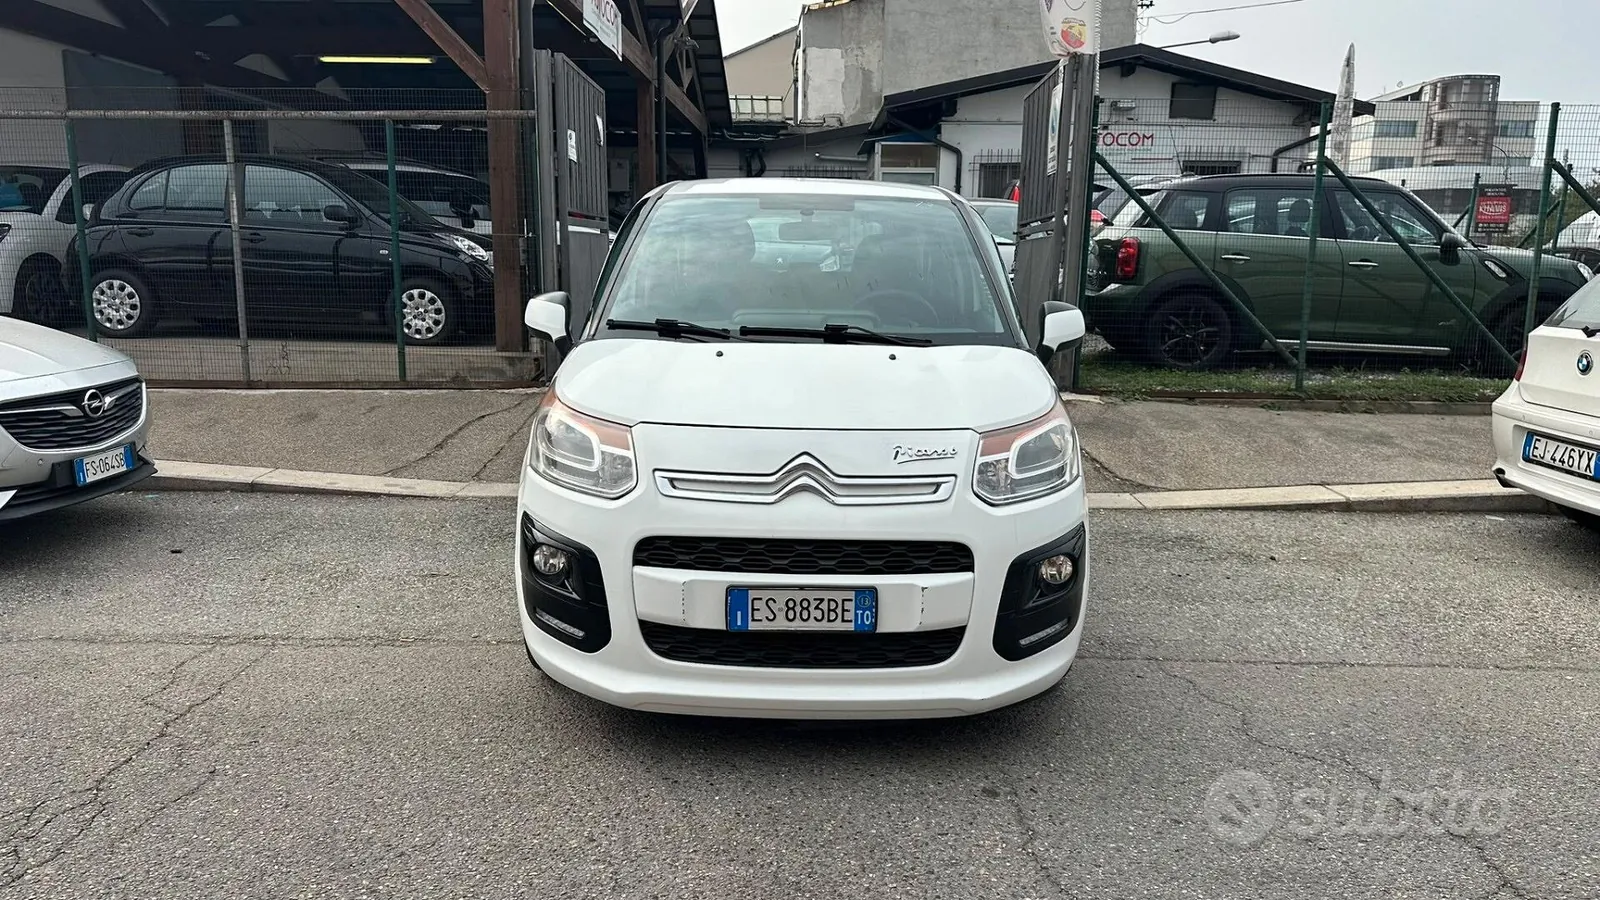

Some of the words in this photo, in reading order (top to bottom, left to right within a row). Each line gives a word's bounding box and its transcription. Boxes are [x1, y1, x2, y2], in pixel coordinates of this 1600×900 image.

[85, 460, 98, 478] FS
[99, 452, 125, 474] 064SB
[892, 445, 958, 464] Picasso
[1532, 438, 1548, 460] EJ
[1550, 445, 1595, 474] 446YX
[751, 597, 777, 622] ES
[785, 597, 853, 623] 883BE
[857, 610, 871, 625] TO
